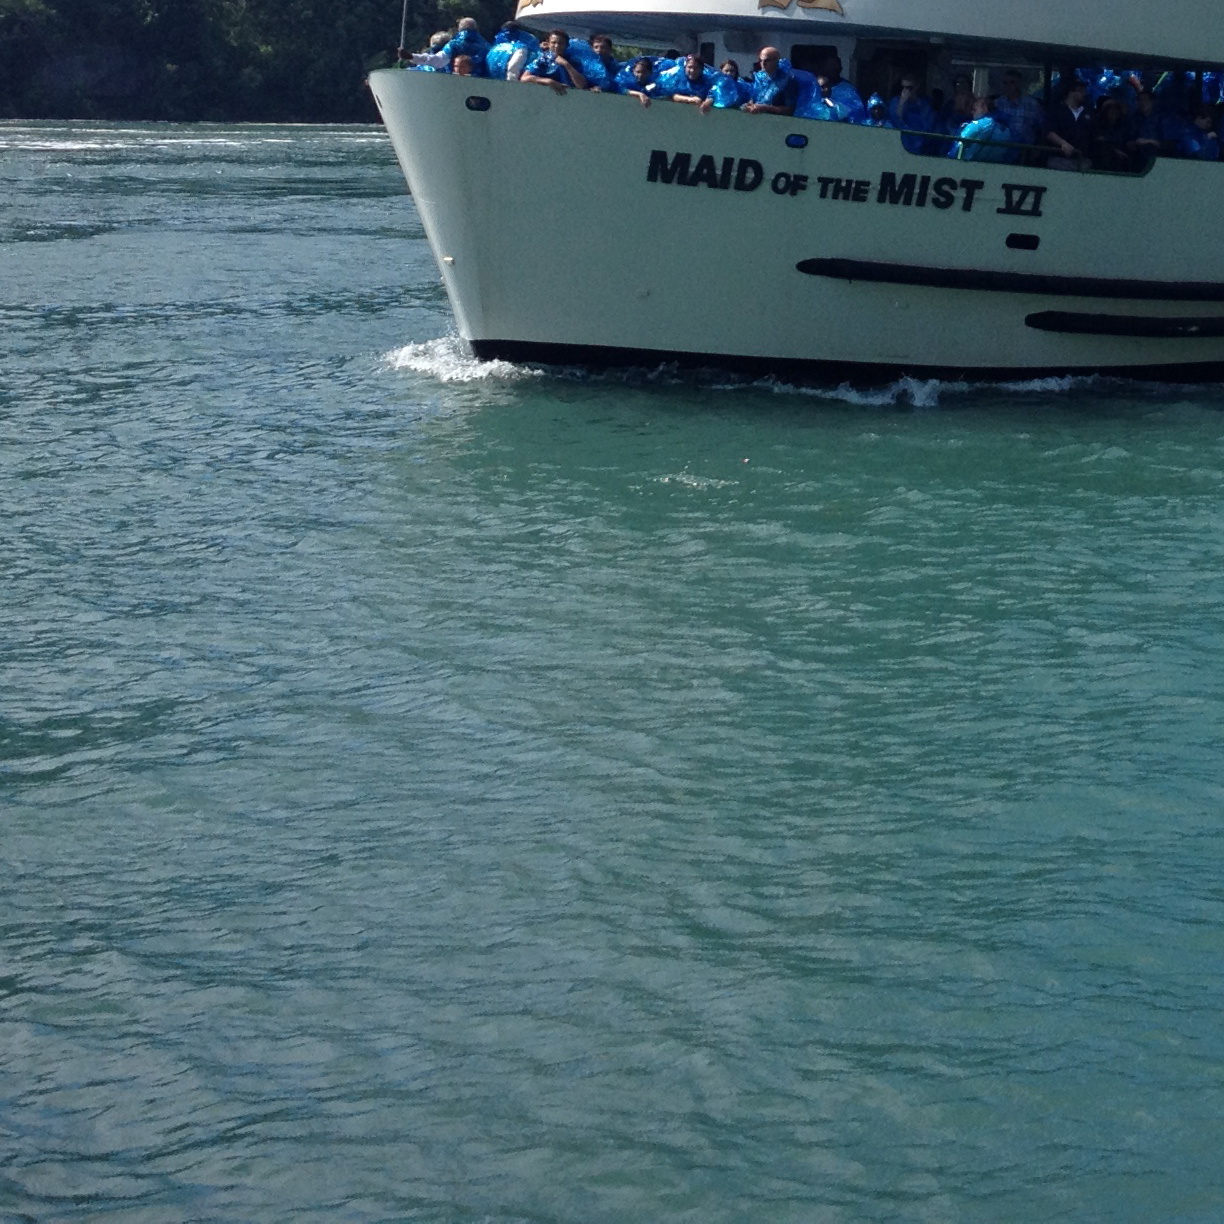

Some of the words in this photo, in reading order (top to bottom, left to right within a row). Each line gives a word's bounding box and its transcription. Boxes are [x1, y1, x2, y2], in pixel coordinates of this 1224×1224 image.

[647, 149, 764, 192] MAID
[771, 172, 809, 196] OF
[817, 176, 871, 203] THE
[877, 171, 985, 212] MIST
[996, 183, 1048, 217] VI
